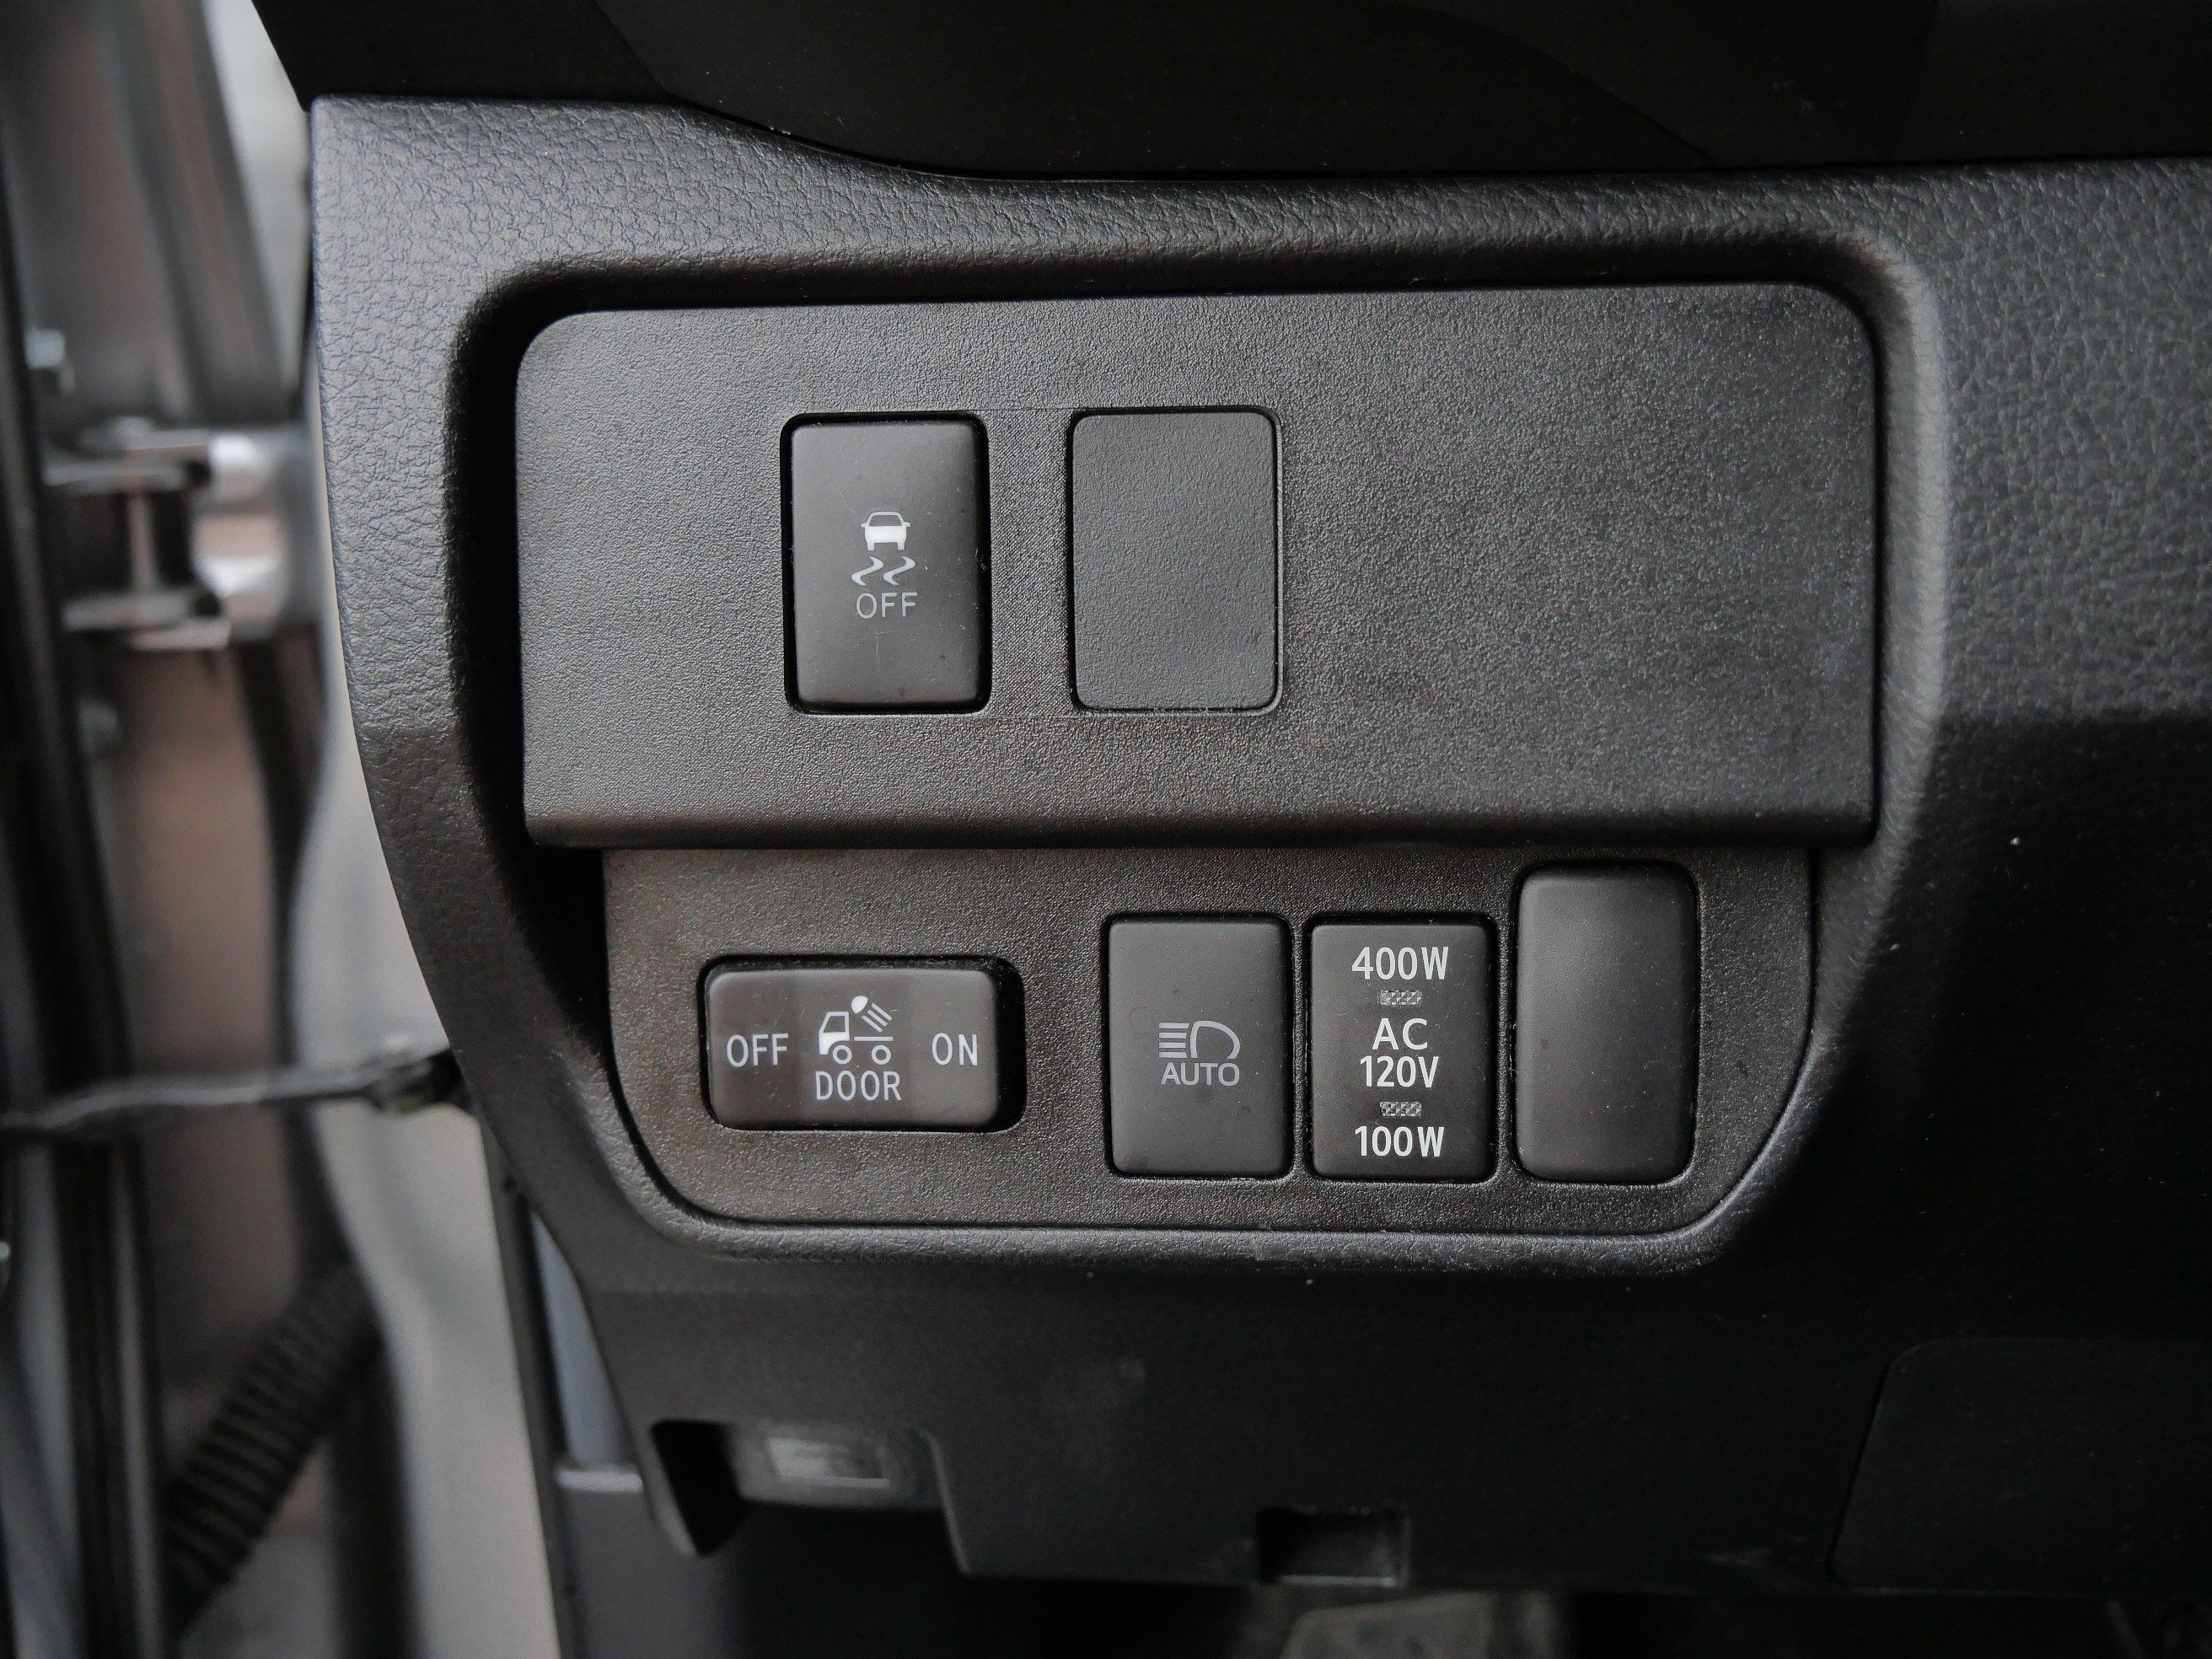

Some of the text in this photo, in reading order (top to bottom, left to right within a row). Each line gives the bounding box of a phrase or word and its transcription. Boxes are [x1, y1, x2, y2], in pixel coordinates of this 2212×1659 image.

[856, 593, 918, 619] OFF
[1351, 946, 1449, 980] 400W
[726, 1033, 789, 1067] OFF
[932, 1032, 979, 1066] ON
[1372, 1017, 1428, 1050] AC
[815, 1071, 902, 1101] DOOR
[1160, 1062, 1241, 1087] AUTO
[1360, 1055, 1439, 1088] 120V
[1355, 1125, 1445, 1157] 100W
